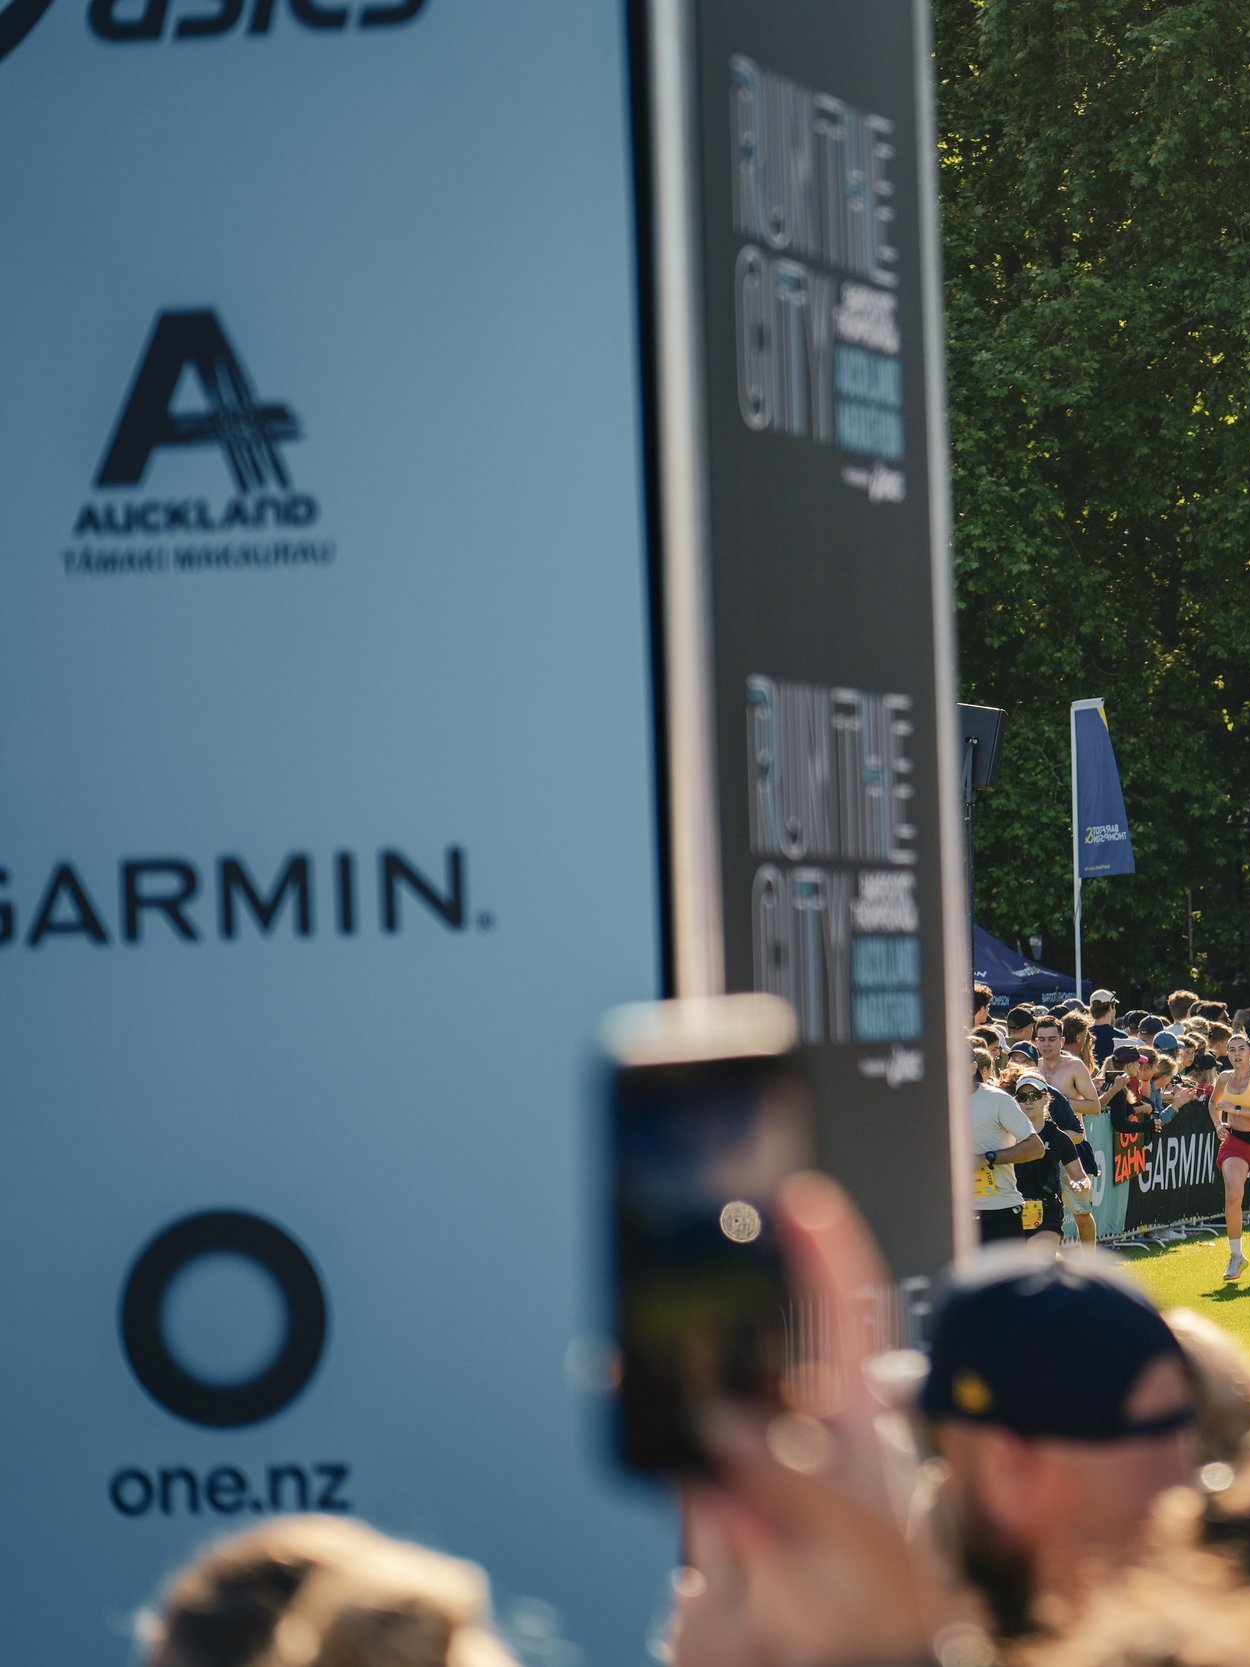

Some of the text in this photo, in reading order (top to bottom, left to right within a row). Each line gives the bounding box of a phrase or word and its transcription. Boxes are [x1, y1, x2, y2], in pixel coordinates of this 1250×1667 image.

[0, 846, 471, 946] ARMIN
[1114, 1145, 1147, 1183] ZAHN
[108, 1461, 352, 1517] one.nz
